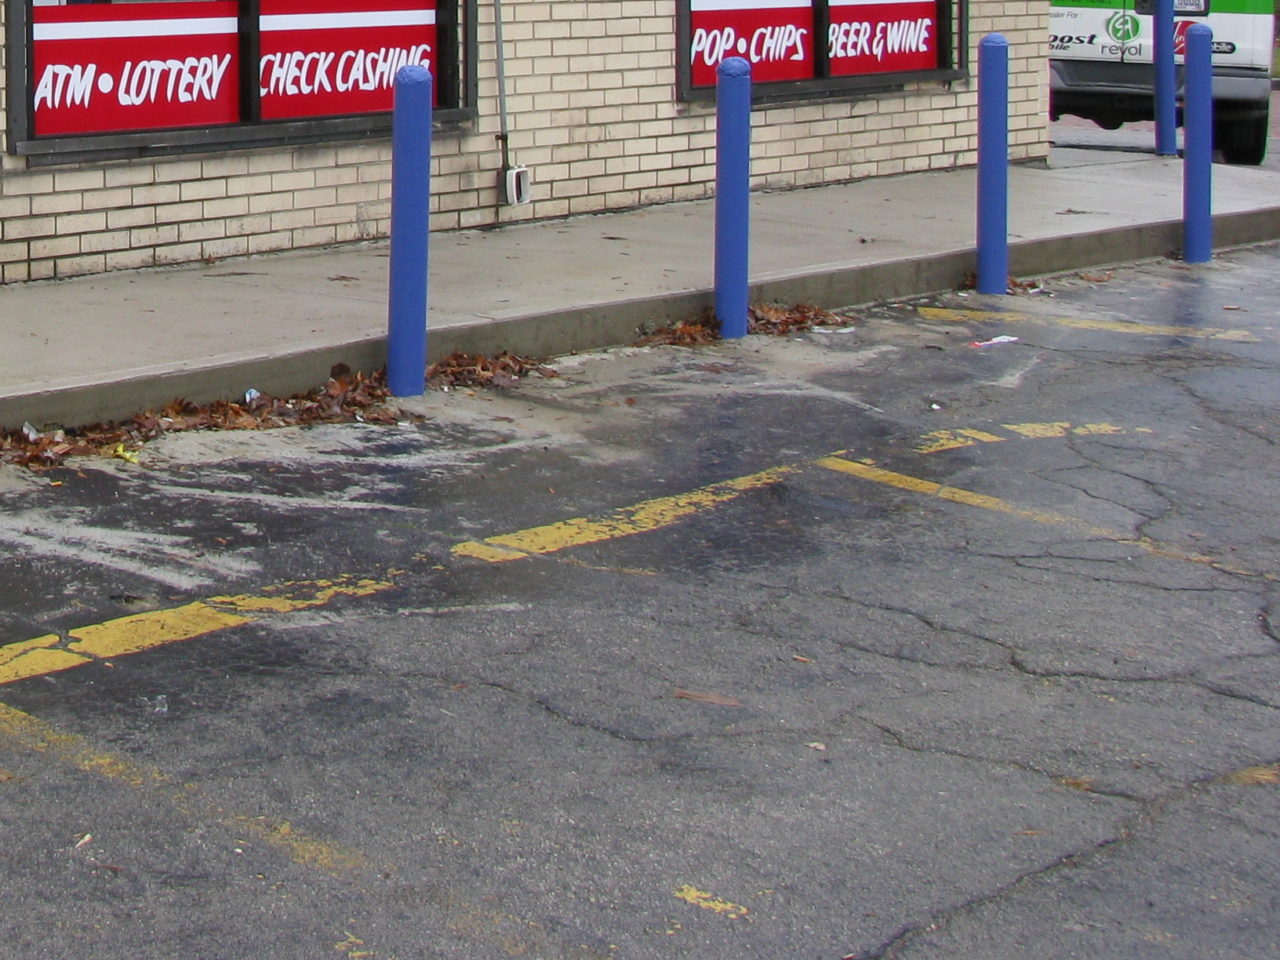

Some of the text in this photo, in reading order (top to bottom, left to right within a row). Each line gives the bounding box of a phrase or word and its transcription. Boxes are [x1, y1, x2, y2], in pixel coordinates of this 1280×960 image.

[690, 24, 807, 66] POP CHIPS
[829, 18, 932, 62] BEER & WINE
[1101, 43, 1141, 57] revol
[34, 53, 231, 112] ATM LOTTERY
[260, 51, 335, 98] CHECK
